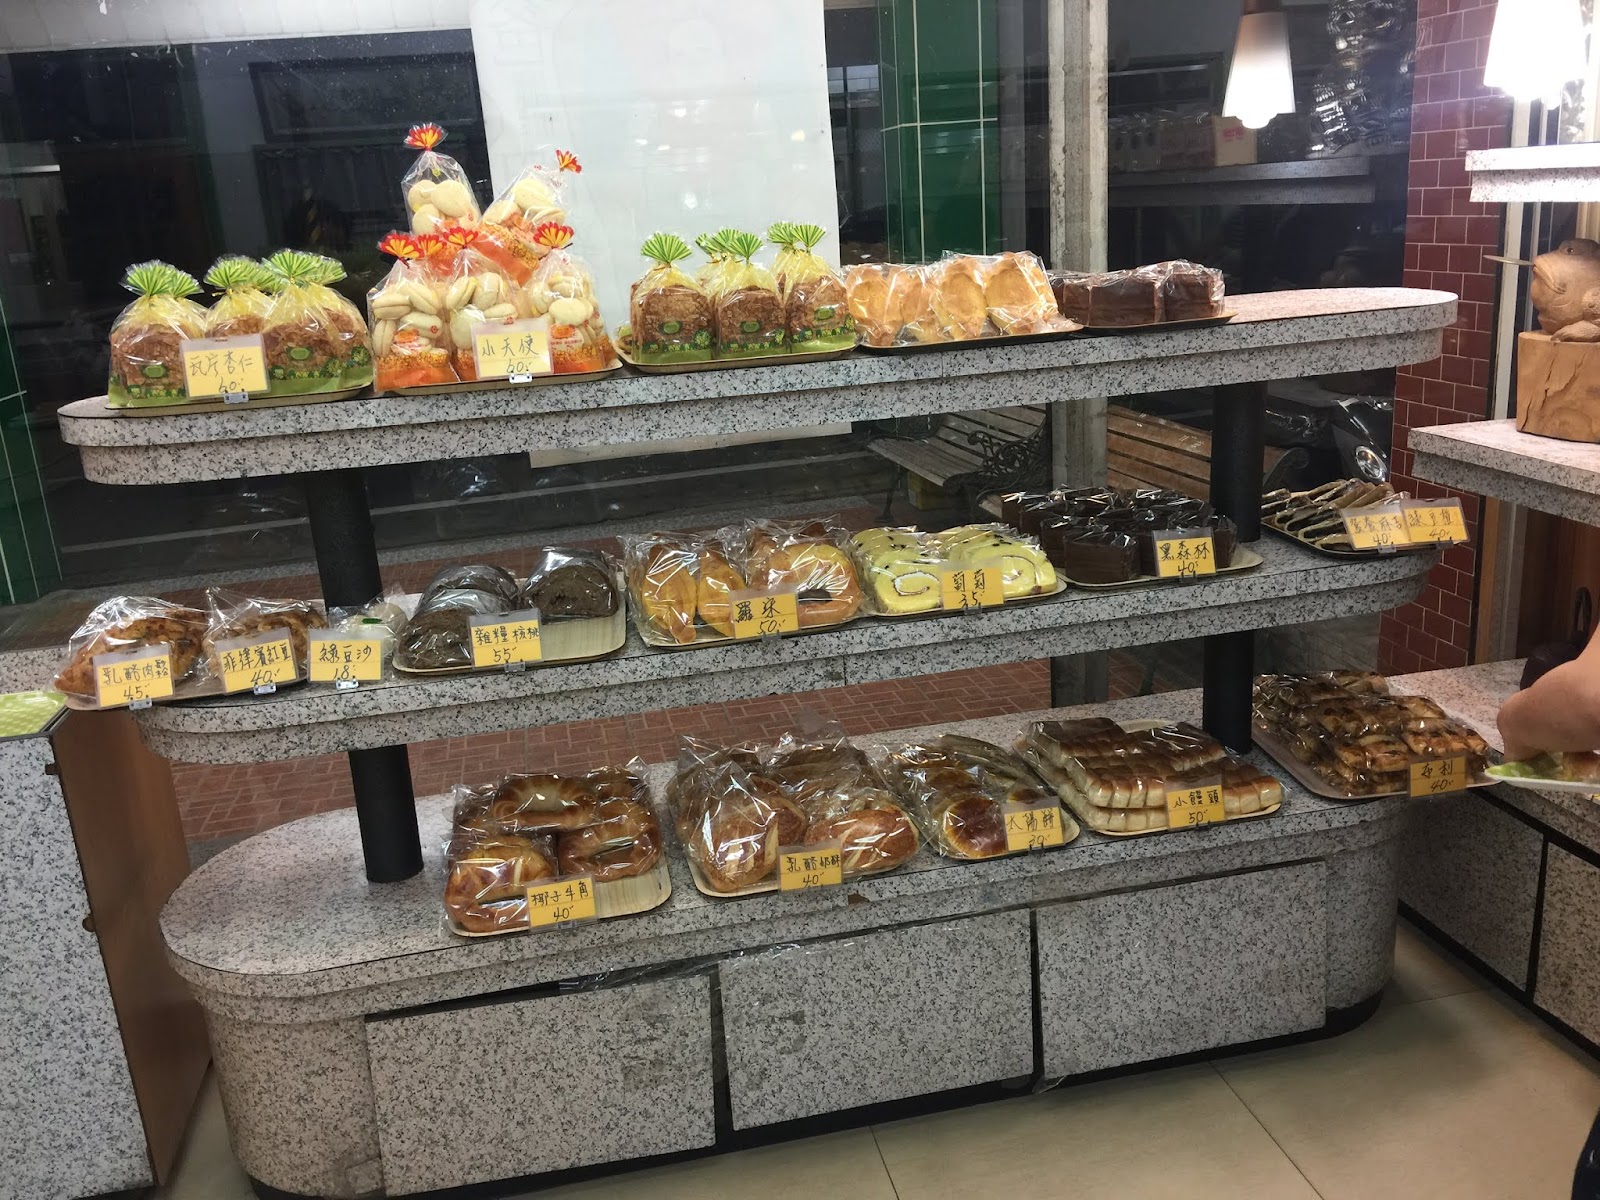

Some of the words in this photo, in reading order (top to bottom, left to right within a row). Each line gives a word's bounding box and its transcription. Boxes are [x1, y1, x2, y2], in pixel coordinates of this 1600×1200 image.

[481, 333, 539, 357] 小天使
[188, 350, 254, 377] 瓦片杏仁
[1158, 540, 1211, 562] 黑森林
[951, 568, 986, 593] 葡萄
[734, 596, 781, 623] 羅宋
[474, 625, 540, 646] 雜糧核桃
[222, 642, 291, 673] 菲律賓紅豆
[319, 643, 373, 664] 綠豆沙
[102, 659, 169, 685] 乳酪肉鬆
[1173, 788, 1220, 808] 小饅頭
[1006, 807, 1055, 832] 太陽餅
[786, 853, 841, 873] 乳酪奶酥
[530, 880, 589, 907] 椰子牛角
